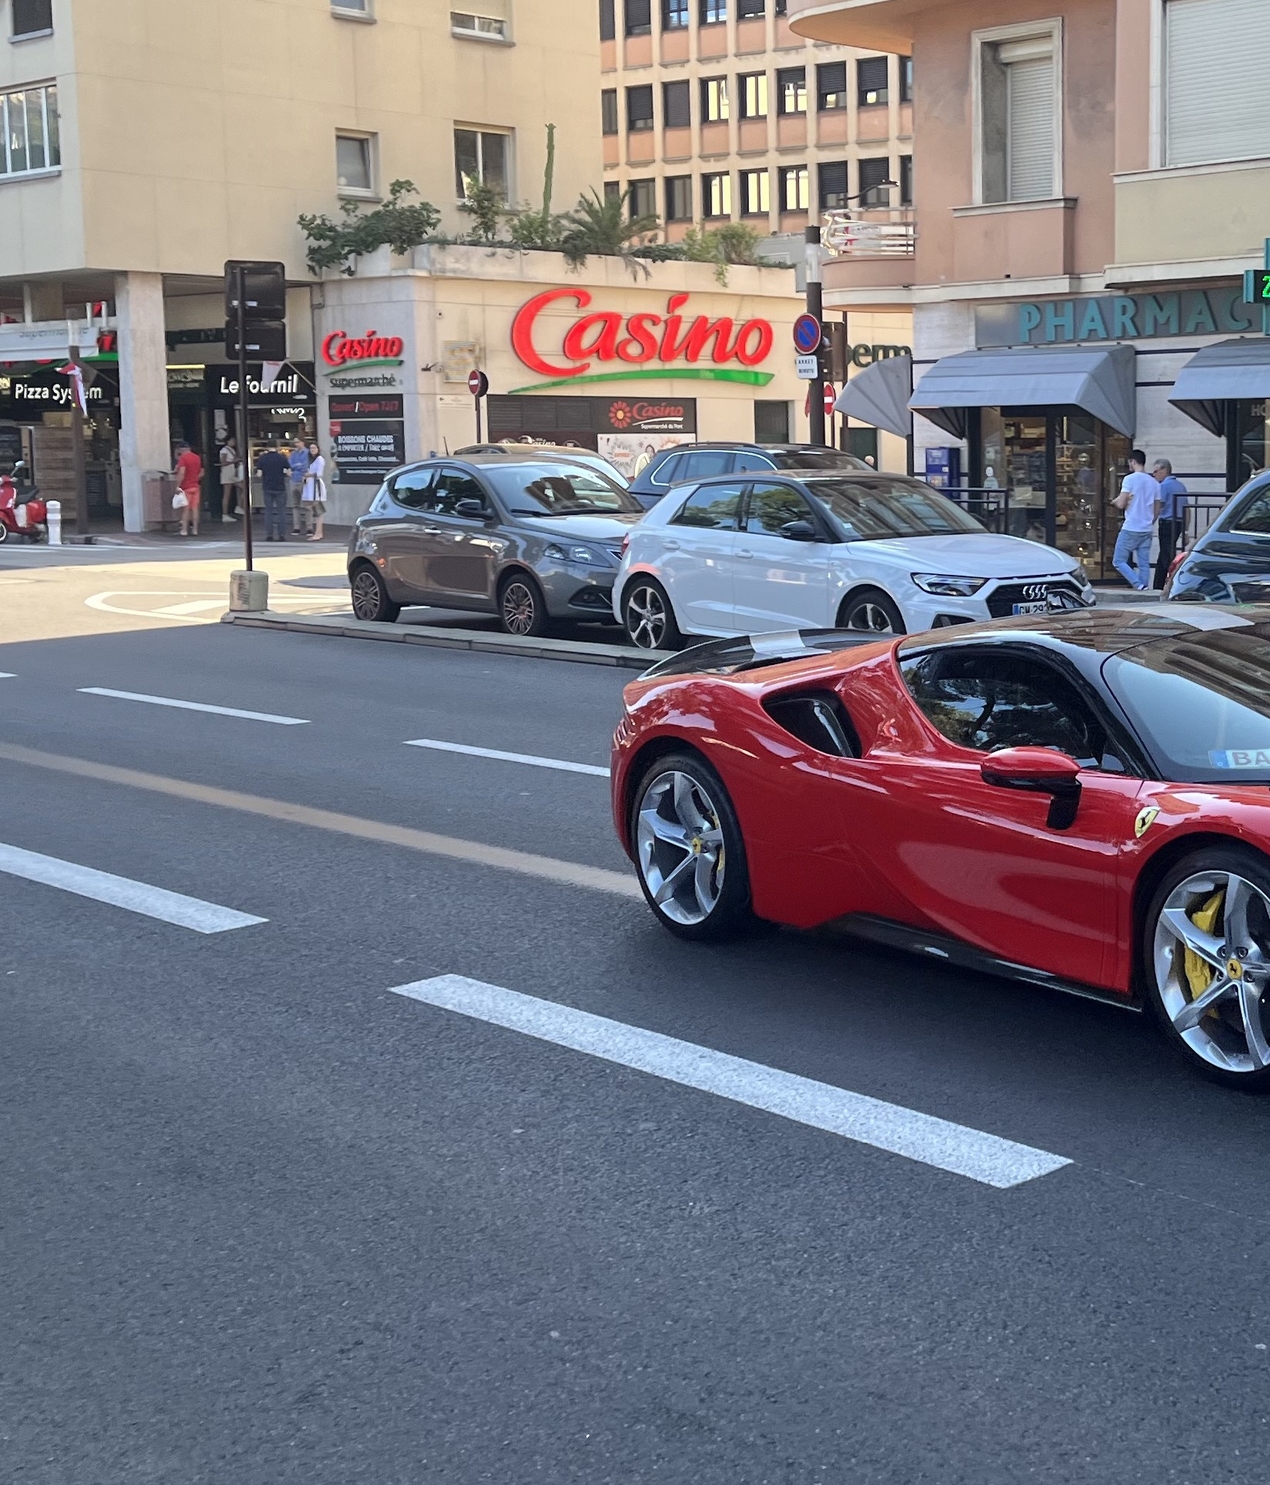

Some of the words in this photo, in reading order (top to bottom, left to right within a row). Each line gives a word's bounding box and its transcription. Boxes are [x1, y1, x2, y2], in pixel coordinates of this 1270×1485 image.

[511, 287, 774, 377] Casino
[321, 330, 403, 367] Casino
[15, 384, 49, 399] Pizza
[220, 376, 239, 393] Le
[631, 402, 685, 420] Casino
